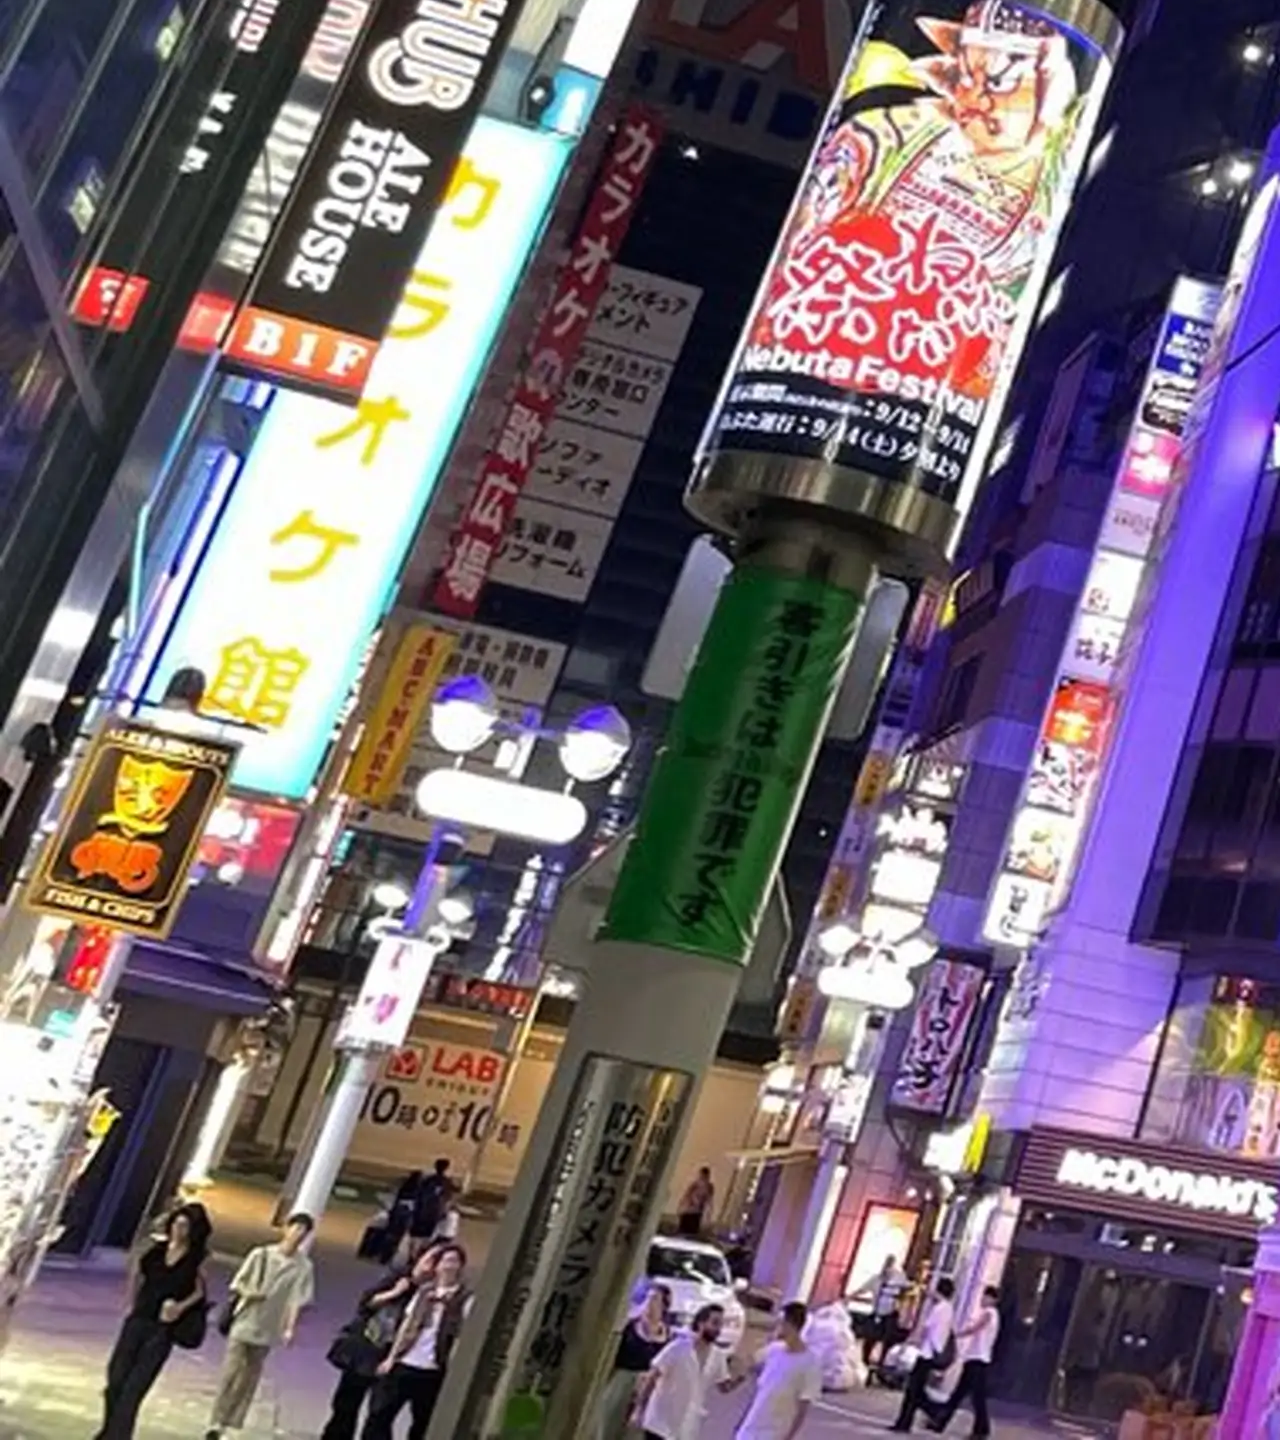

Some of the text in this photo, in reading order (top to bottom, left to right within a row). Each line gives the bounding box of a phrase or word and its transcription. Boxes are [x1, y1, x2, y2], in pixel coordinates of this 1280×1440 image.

[285, 118, 391, 293] HOUSE
[362, 131, 432, 234] ALE
[243, 313, 368, 381] B1F
[745, 343, 853, 383] Nebuta
[854, 354, 984, 427] Festival
[198, 156, 501, 730] カラオケ館
